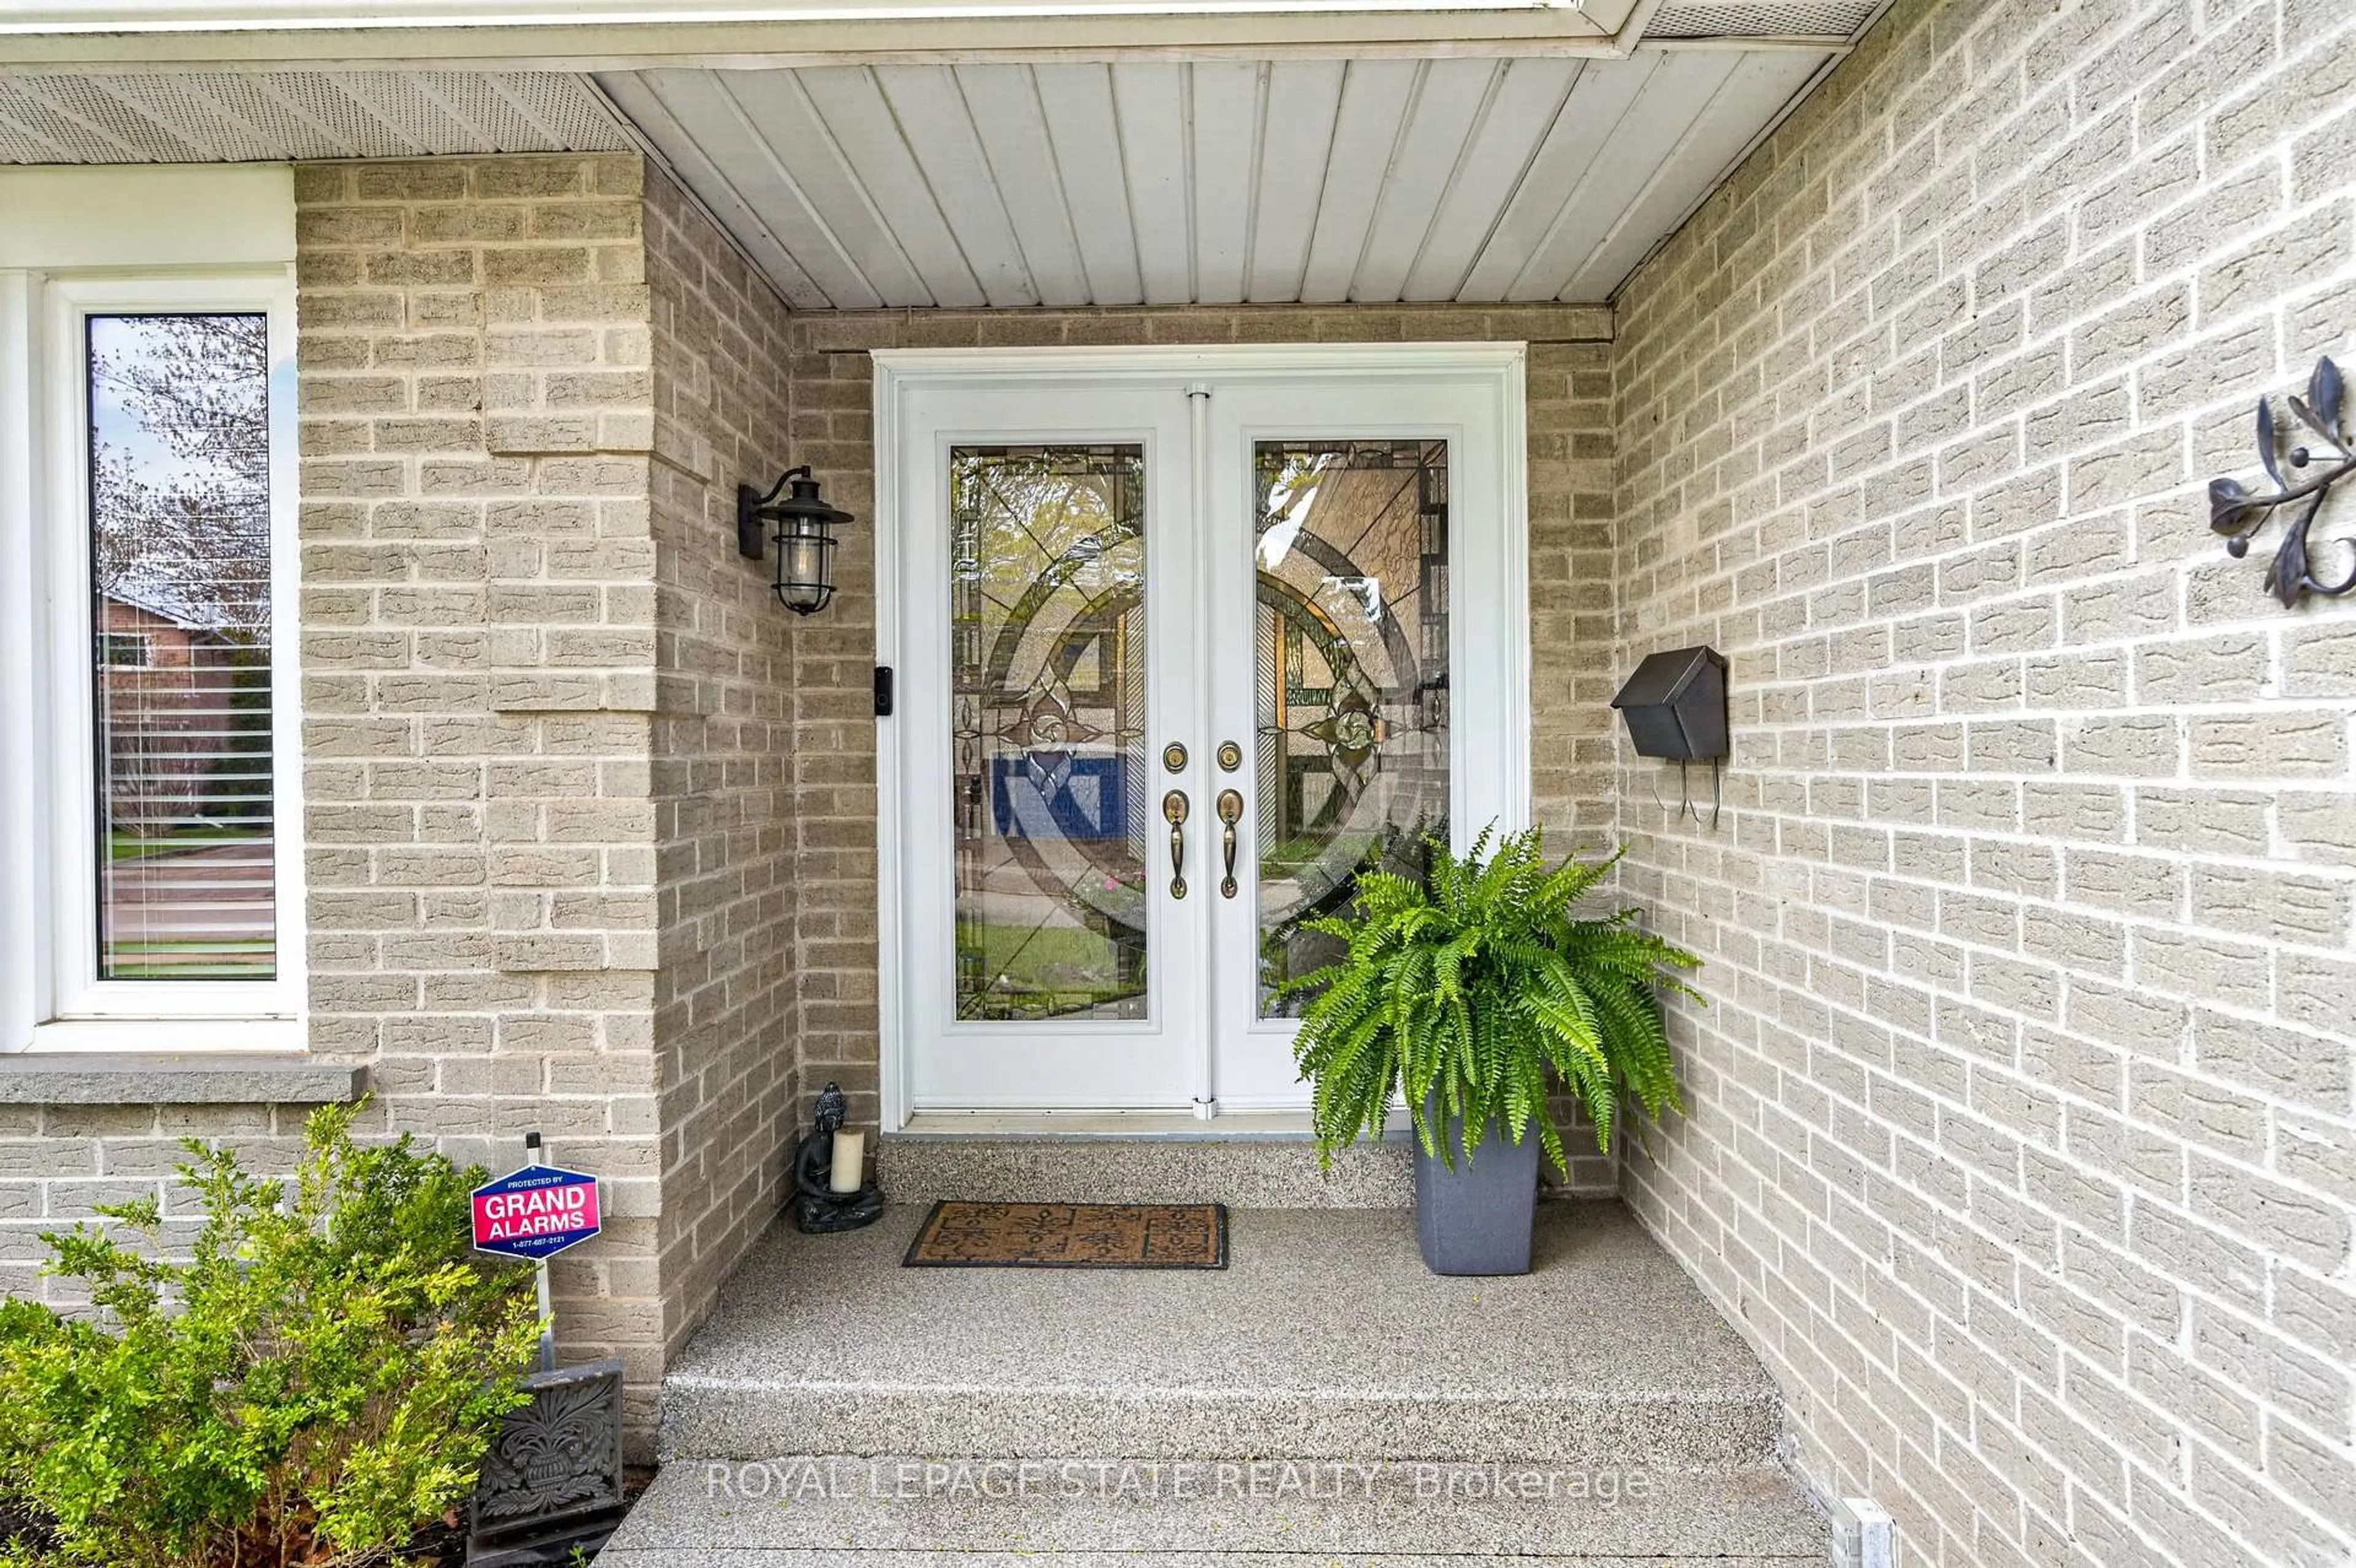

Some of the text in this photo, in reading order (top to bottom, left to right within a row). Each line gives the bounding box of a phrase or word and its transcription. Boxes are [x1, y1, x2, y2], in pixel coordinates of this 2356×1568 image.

[507, 1178, 551, 1188] PROTECTED
[485, 1186, 585, 1220] GRAND
[489, 1212, 584, 1239] ALARMS
